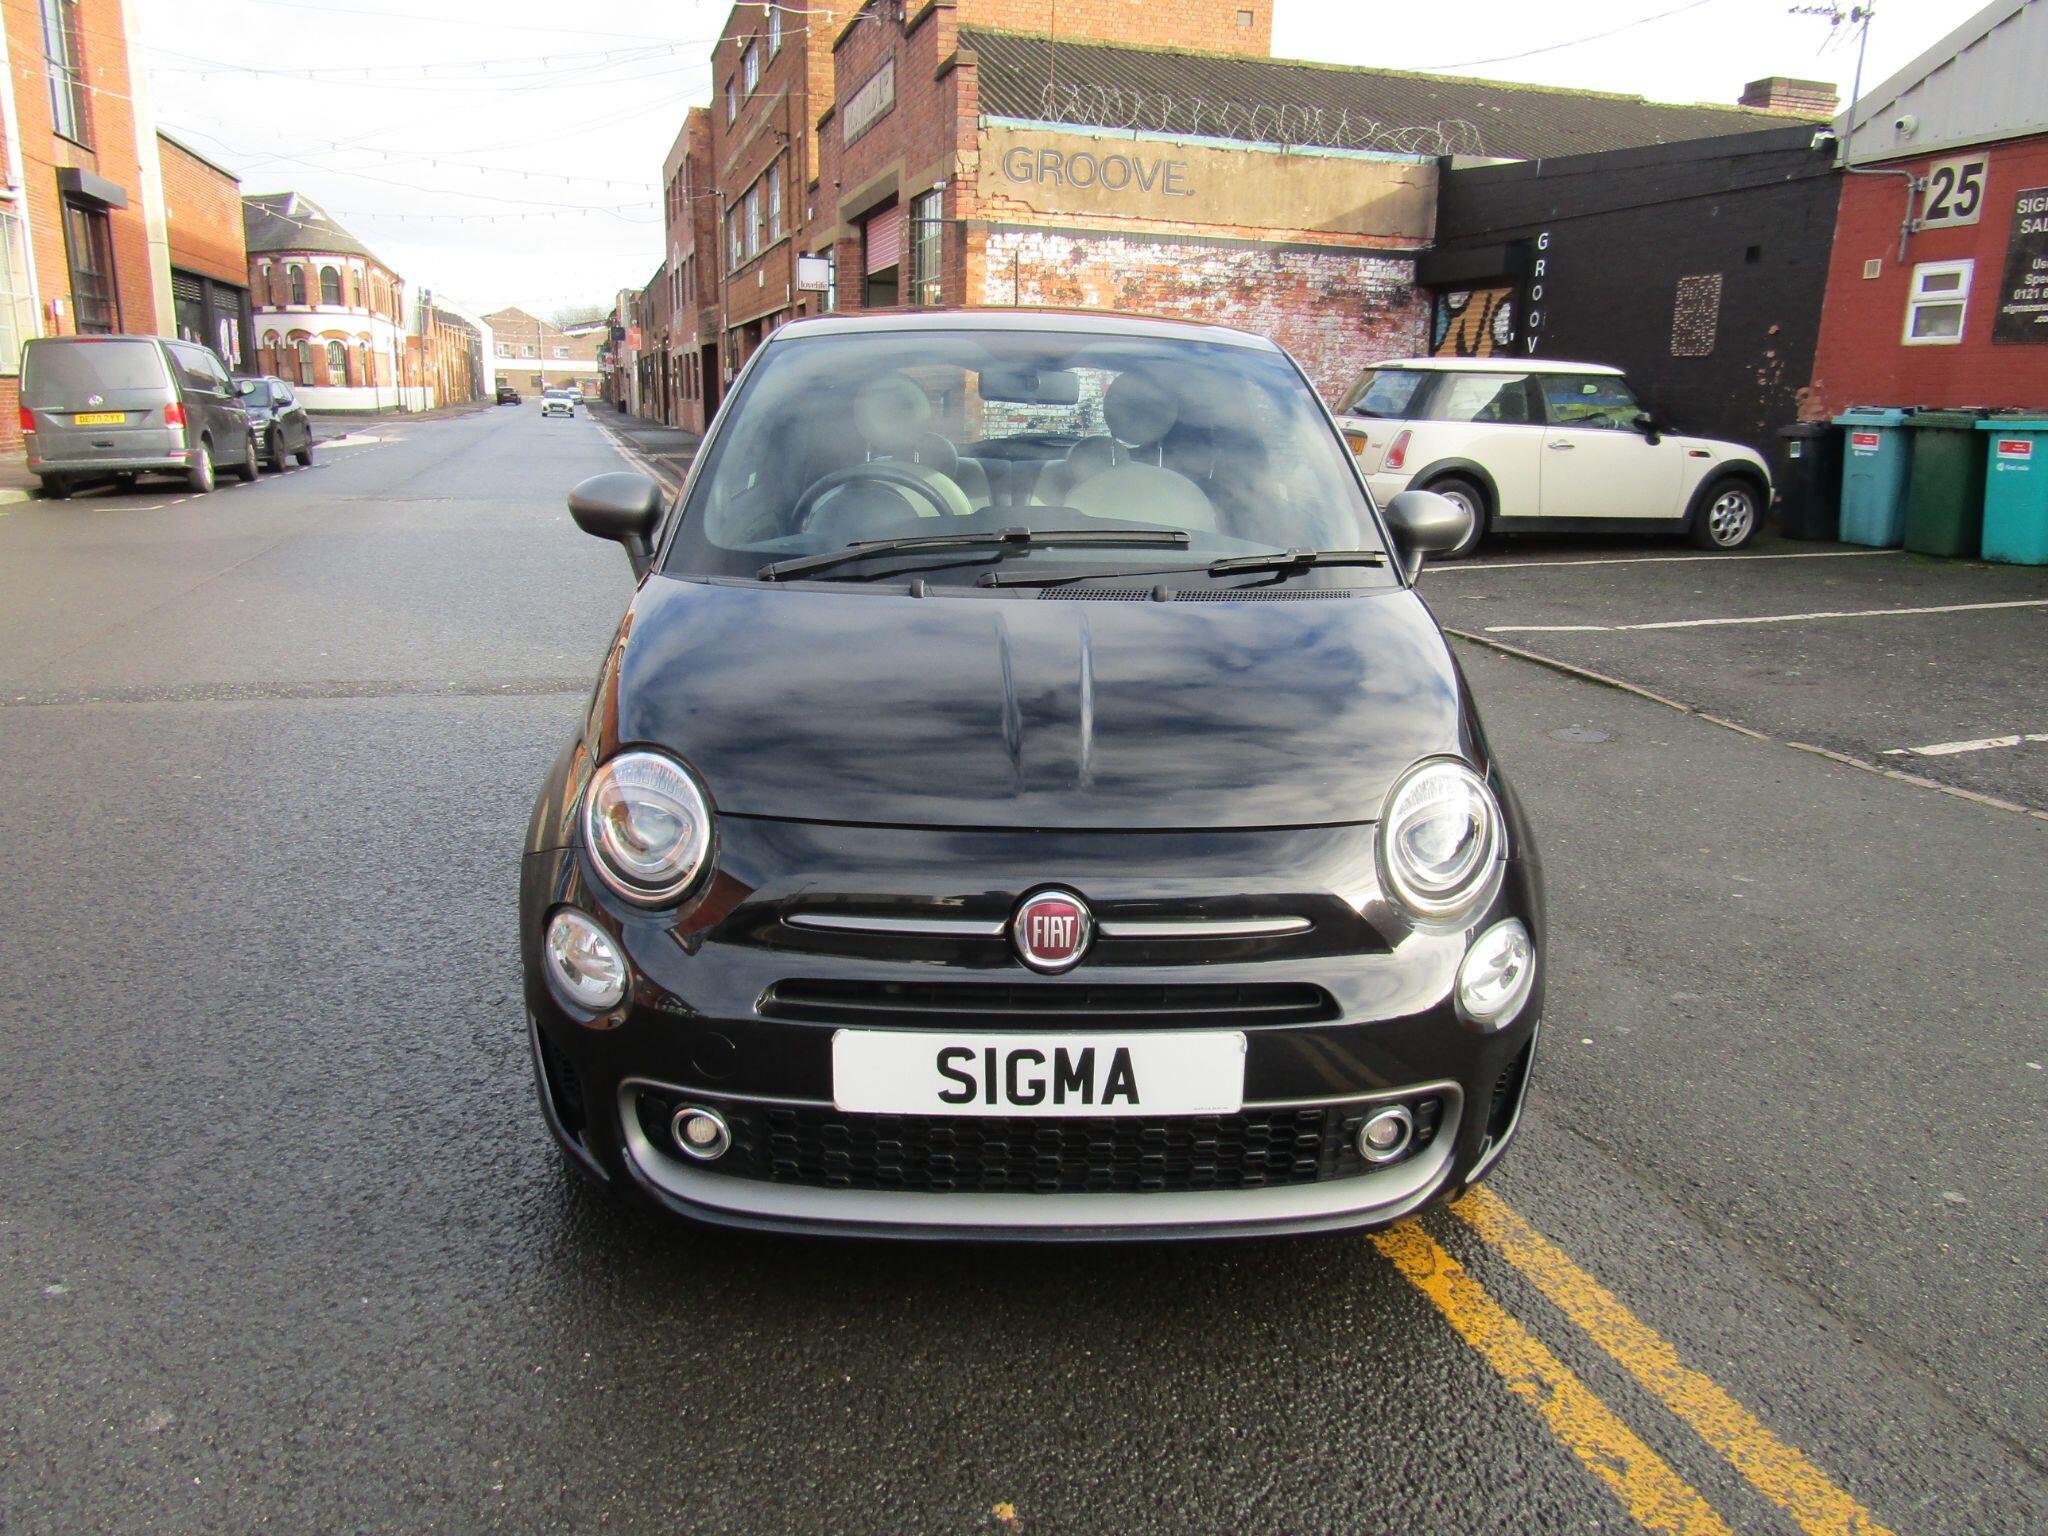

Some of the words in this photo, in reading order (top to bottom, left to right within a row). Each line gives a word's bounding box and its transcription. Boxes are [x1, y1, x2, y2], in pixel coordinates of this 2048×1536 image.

[1003, 146, 1188, 196] GROOVE
[1925, 162, 1984, 220] 25
[2013, 288, 2040, 300] 0121
[1032, 915, 1075, 948] FIAT
[936, 1046, 1140, 1106] SIGMA
